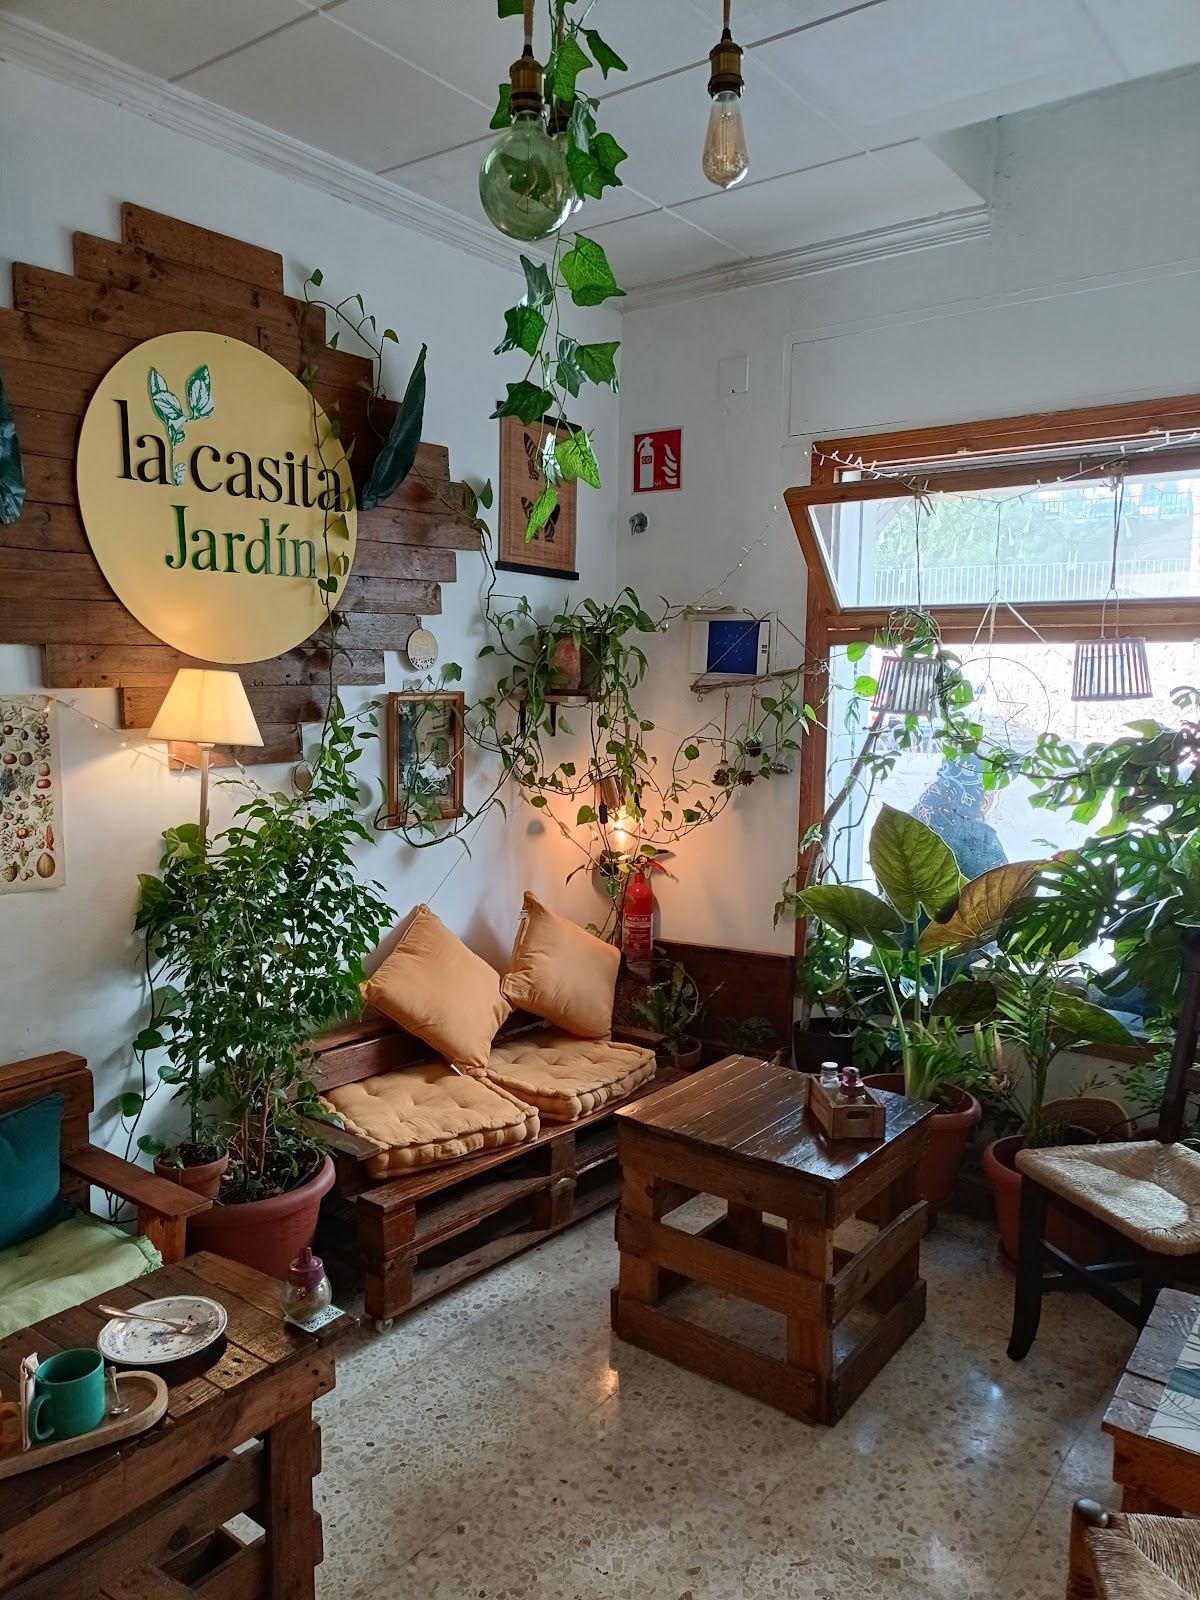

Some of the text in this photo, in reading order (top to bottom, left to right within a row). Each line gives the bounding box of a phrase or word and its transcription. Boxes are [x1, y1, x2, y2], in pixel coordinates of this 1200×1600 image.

[113, 399, 348, 513] la casita
[164, 504, 318, 579] Jardín
